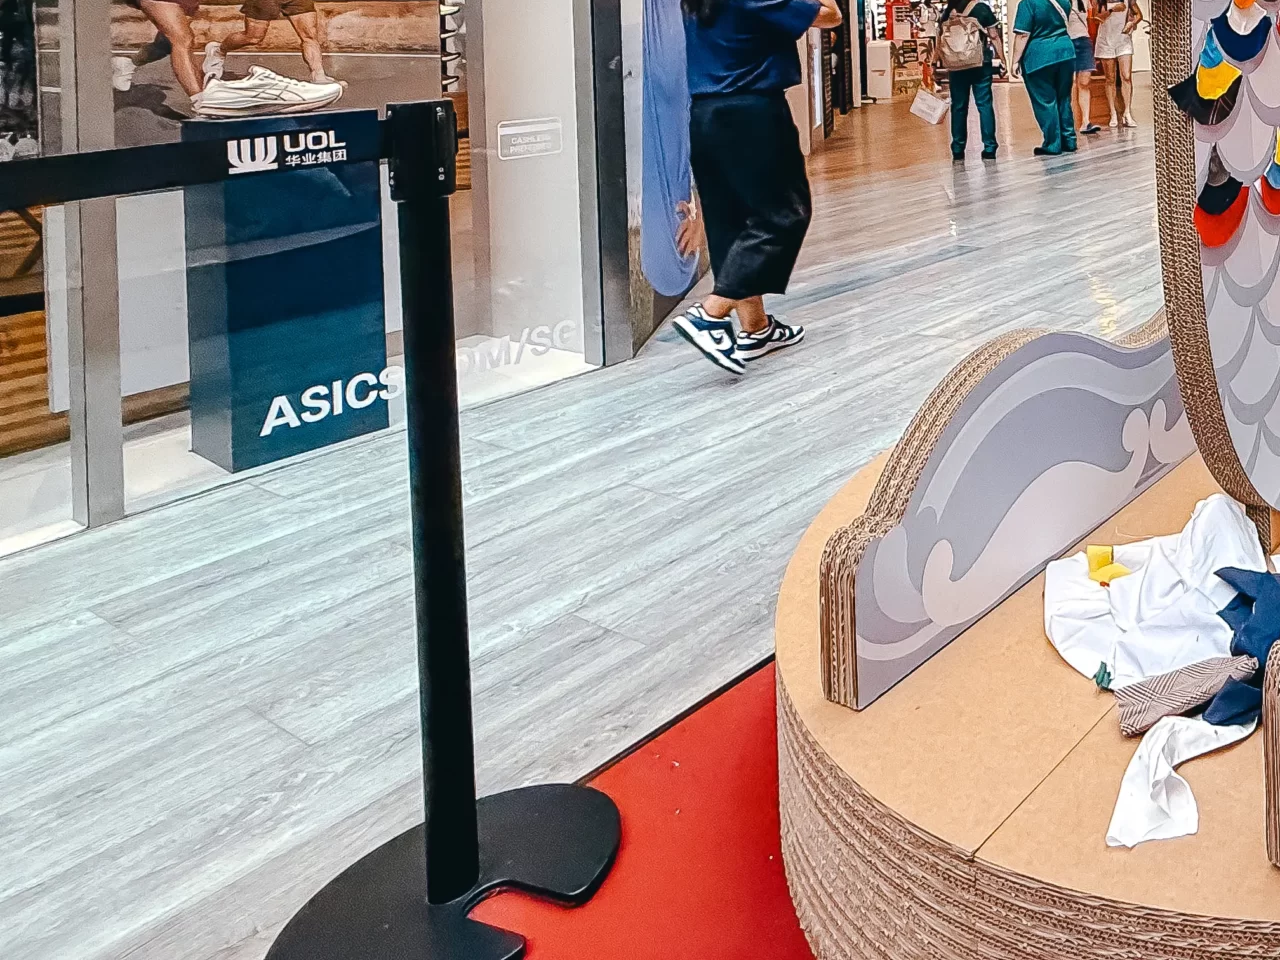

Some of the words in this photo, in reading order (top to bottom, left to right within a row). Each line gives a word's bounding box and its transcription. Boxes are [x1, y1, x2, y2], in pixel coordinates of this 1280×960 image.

[283, 130, 346, 152] UOL
[285, 149, 347, 166] 华业集团
